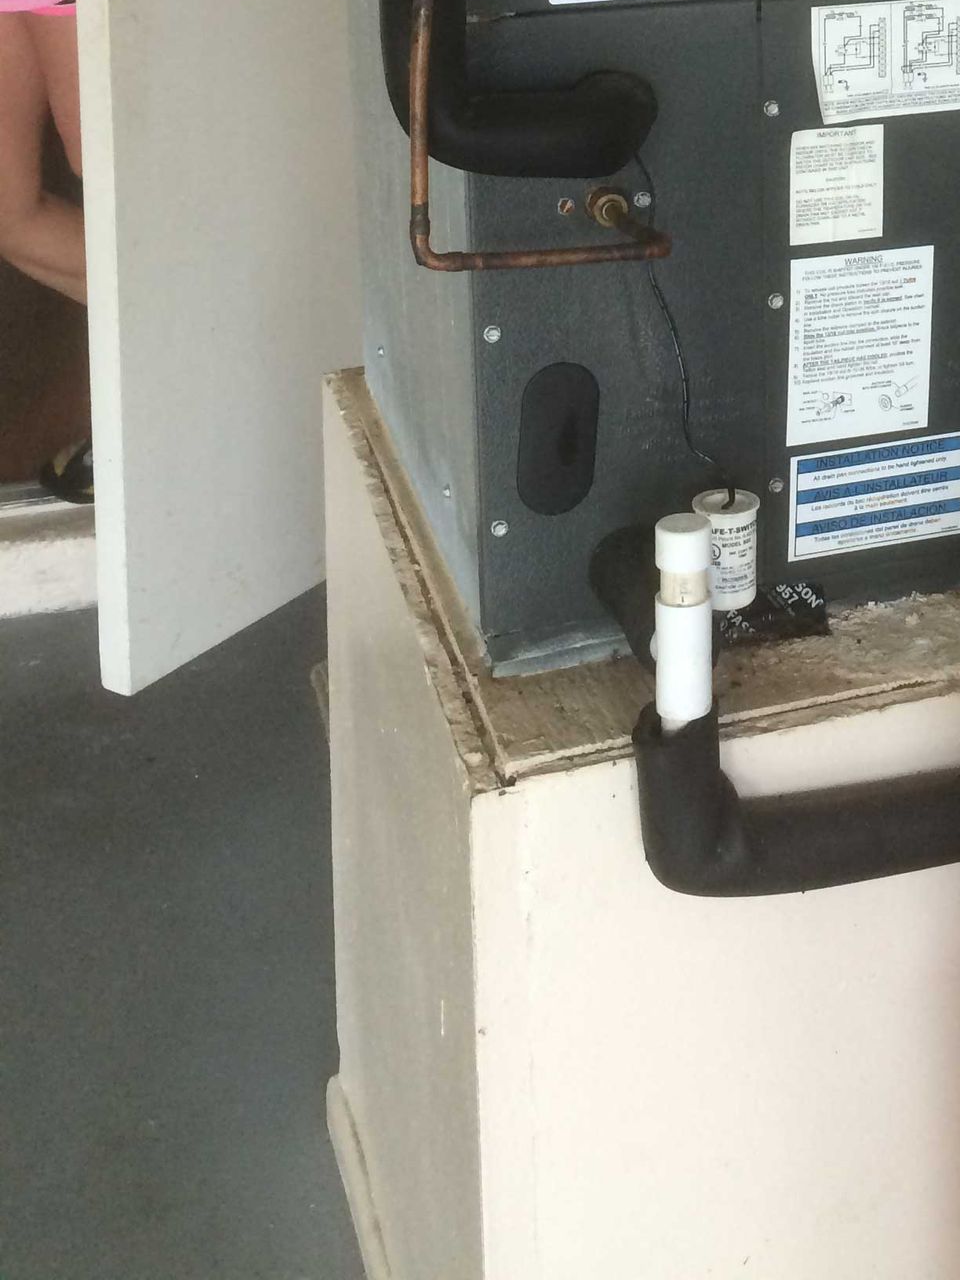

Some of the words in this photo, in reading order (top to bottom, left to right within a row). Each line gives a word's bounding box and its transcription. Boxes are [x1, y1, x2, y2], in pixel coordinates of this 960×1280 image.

[844, 254, 884, 266] WARNING
[816, 447, 899, 469] INSTALLATION
[901, 439, 945, 456] NOTICE
[815, 488, 840, 500] AVIS
[812, 519, 848, 535] AVISO
[850, 517, 867, 527] DE
